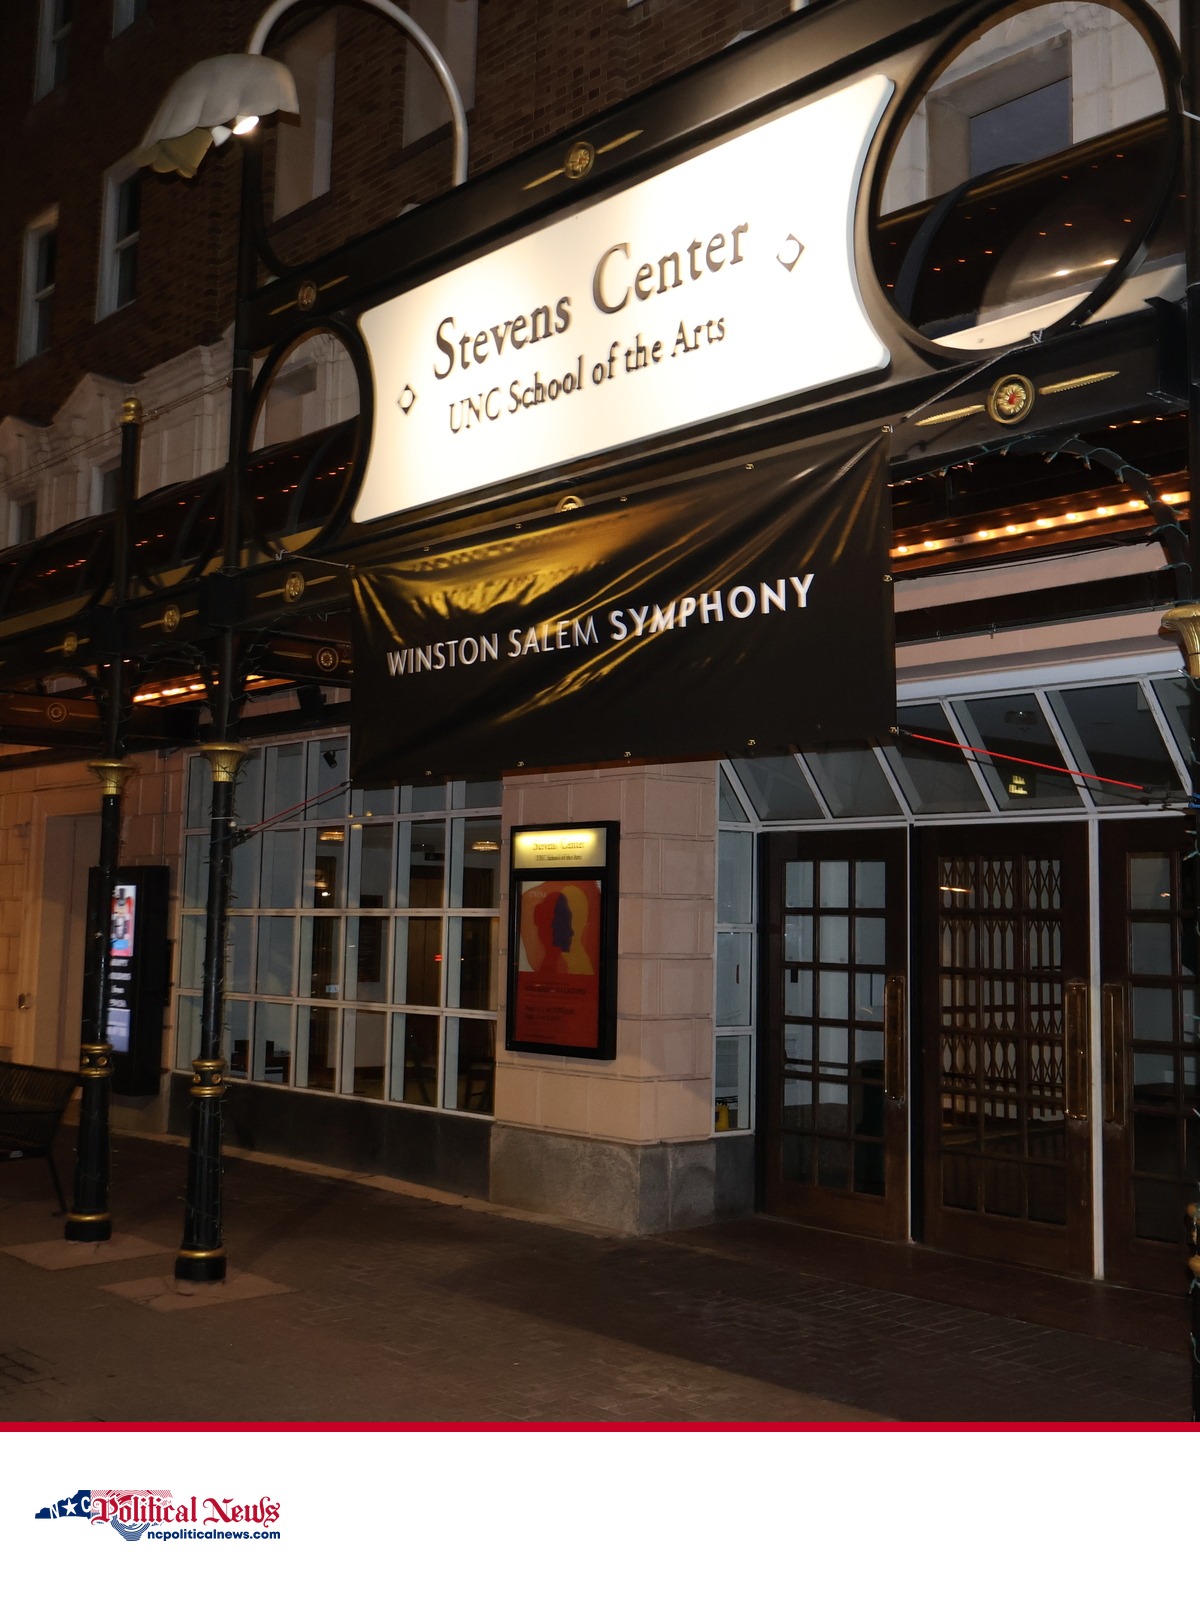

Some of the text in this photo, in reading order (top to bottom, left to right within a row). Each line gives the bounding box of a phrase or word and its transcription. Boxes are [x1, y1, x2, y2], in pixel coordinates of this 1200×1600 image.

[433, 221, 749, 381] Stevens Center
[447, 316, 726, 434] UNC School of the Arts
[386, 573, 815, 677] WINSTON SALEM SYMPHONY
